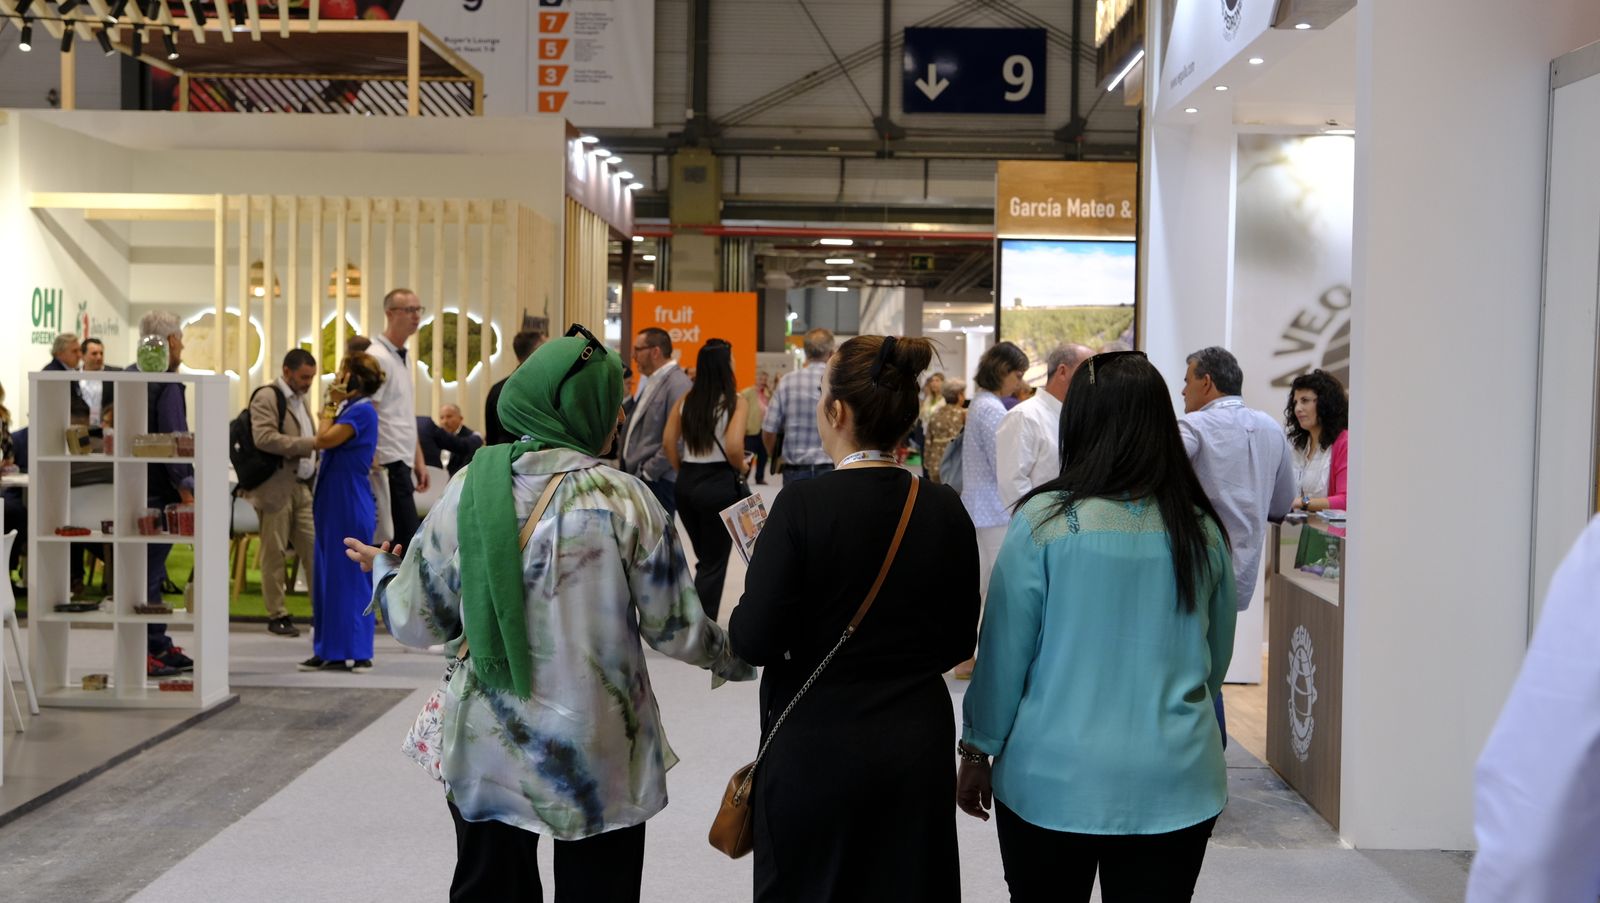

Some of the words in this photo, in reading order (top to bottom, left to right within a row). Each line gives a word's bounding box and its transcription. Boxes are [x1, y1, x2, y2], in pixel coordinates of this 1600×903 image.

[545, 15, 558, 32] 7
[545, 41, 558, 58] 5
[545, 67, 558, 84] 3
[1002, 54, 1034, 102] 9
[546, 94, 555, 111] 1
[1009, 196, 1062, 218] García
[1066, 197, 1116, 218] Mateo
[1120, 199, 1133, 218] &
[654, 304, 694, 324] fruit
[668, 325, 700, 343] ext
